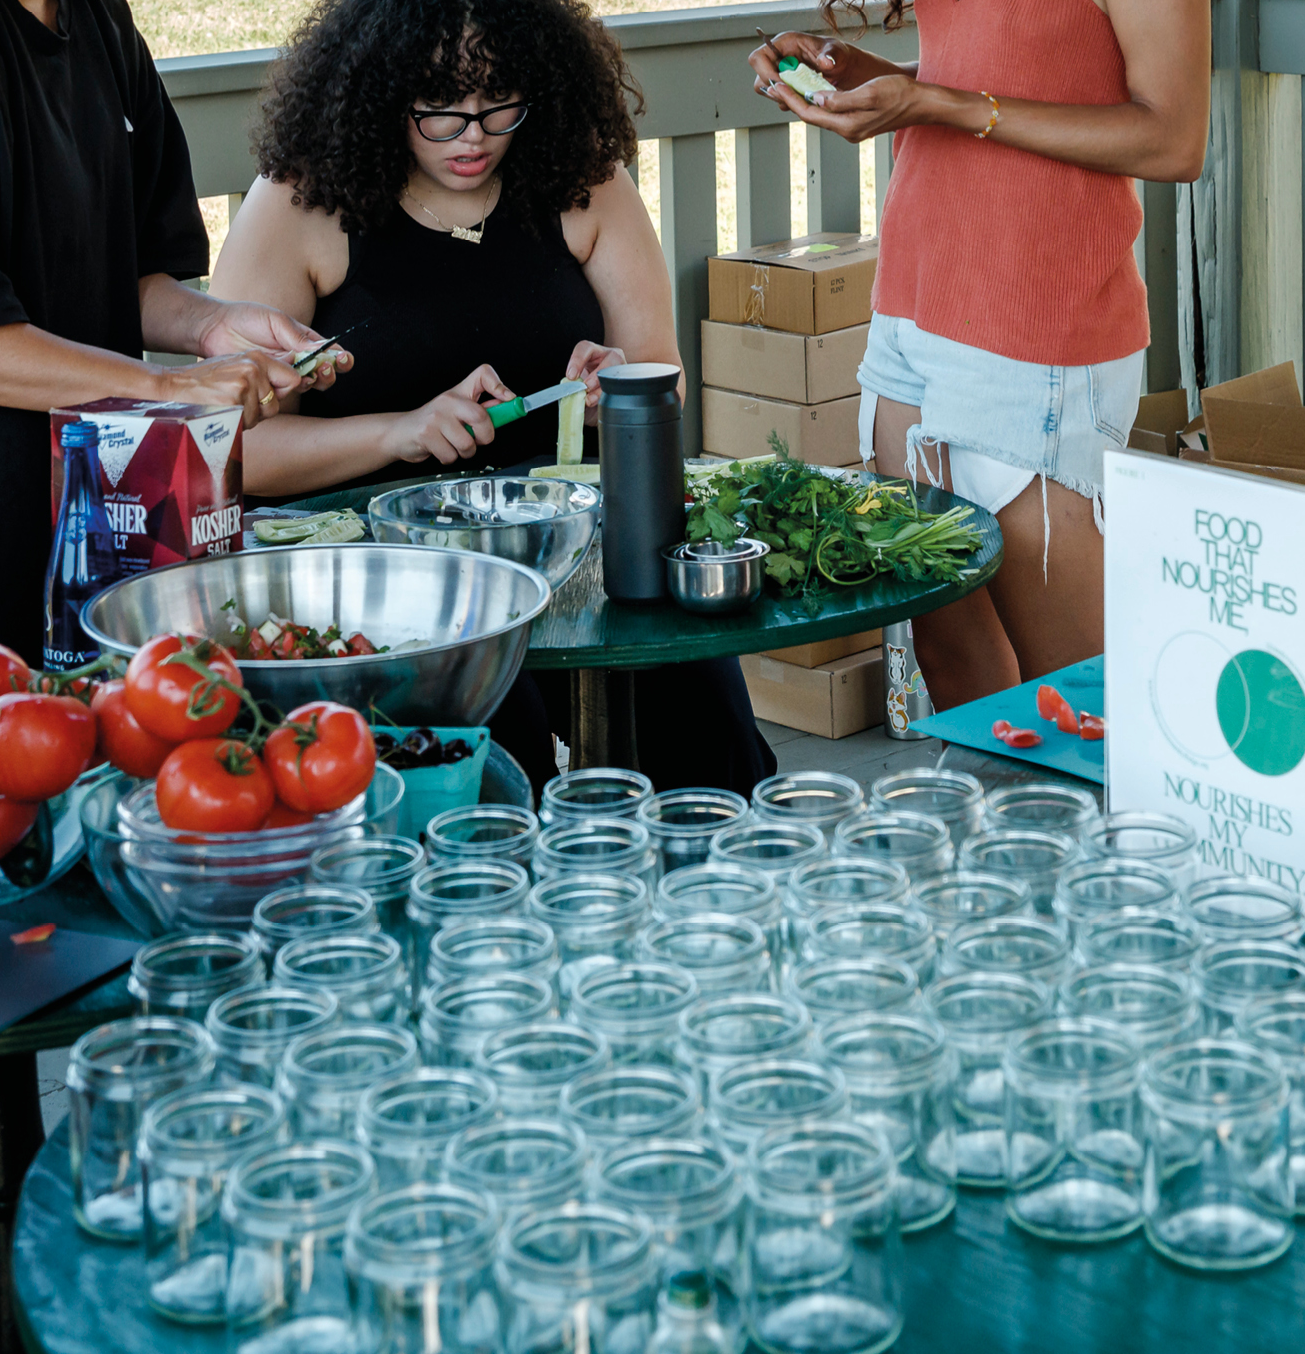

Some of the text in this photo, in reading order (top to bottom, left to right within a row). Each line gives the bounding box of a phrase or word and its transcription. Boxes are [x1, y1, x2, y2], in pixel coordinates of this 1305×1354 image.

[817, 338, 824, 348] 12
[810, 411, 817, 420] 12
[108, 437, 135, 449] Crystal
[104, 502, 148, 534] SHER
[191, 504, 241, 546] KOSHER
[1195, 508, 1263, 549] FOOD
[114, 534, 128, 550] LT
[207, 538, 231, 557] SALT
[1200, 537, 1259, 576] THAT
[1161, 556, 1297, 616] NOURISHES
[1210, 596, 1249, 637] ME,
[44, 647, 85, 663] ATOGA
[841, 675, 847, 684] 12
[1163, 770, 1293, 836] NOURISHES
[1208, 813, 1248, 848] MY
